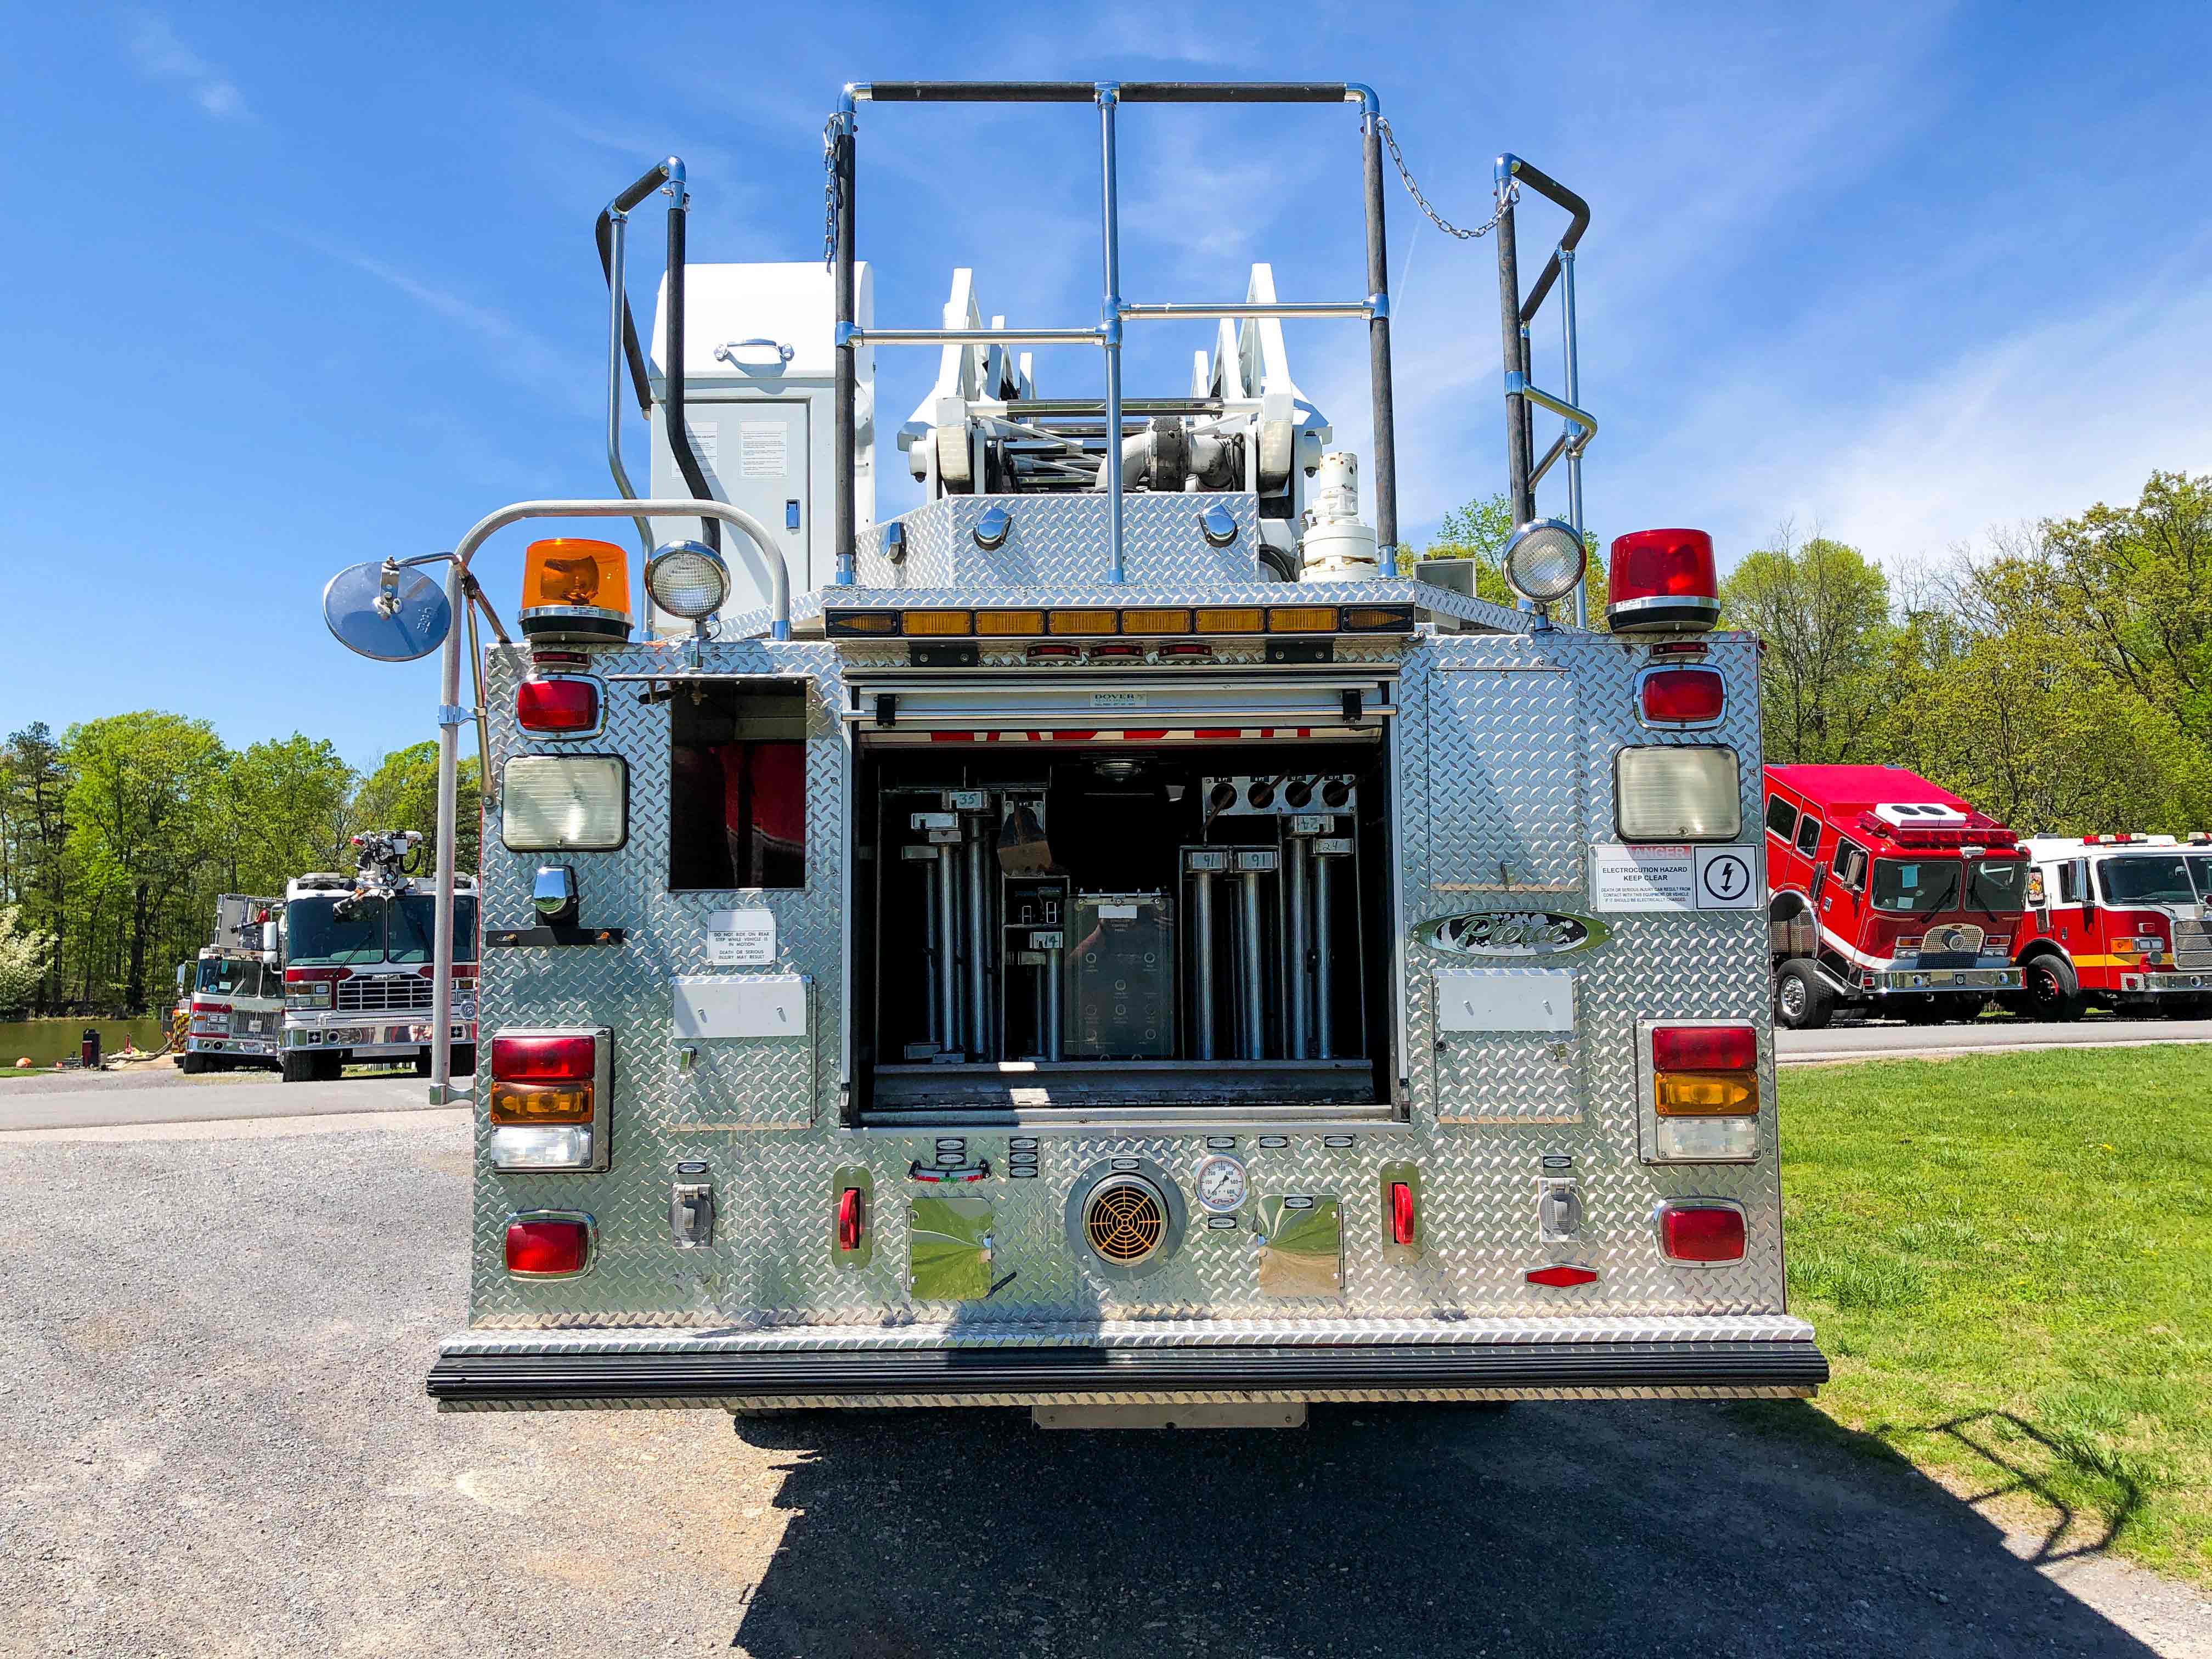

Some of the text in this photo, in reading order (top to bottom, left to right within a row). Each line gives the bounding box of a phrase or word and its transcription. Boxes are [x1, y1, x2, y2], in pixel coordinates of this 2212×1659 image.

[960, 794, 975, 805] 35
[1322, 840, 1338, 851] 24
[1626, 847, 1685, 857] ANGER
[1456, 915, 1568, 950] Pierce
[1044, 935, 1058, 947] 14
